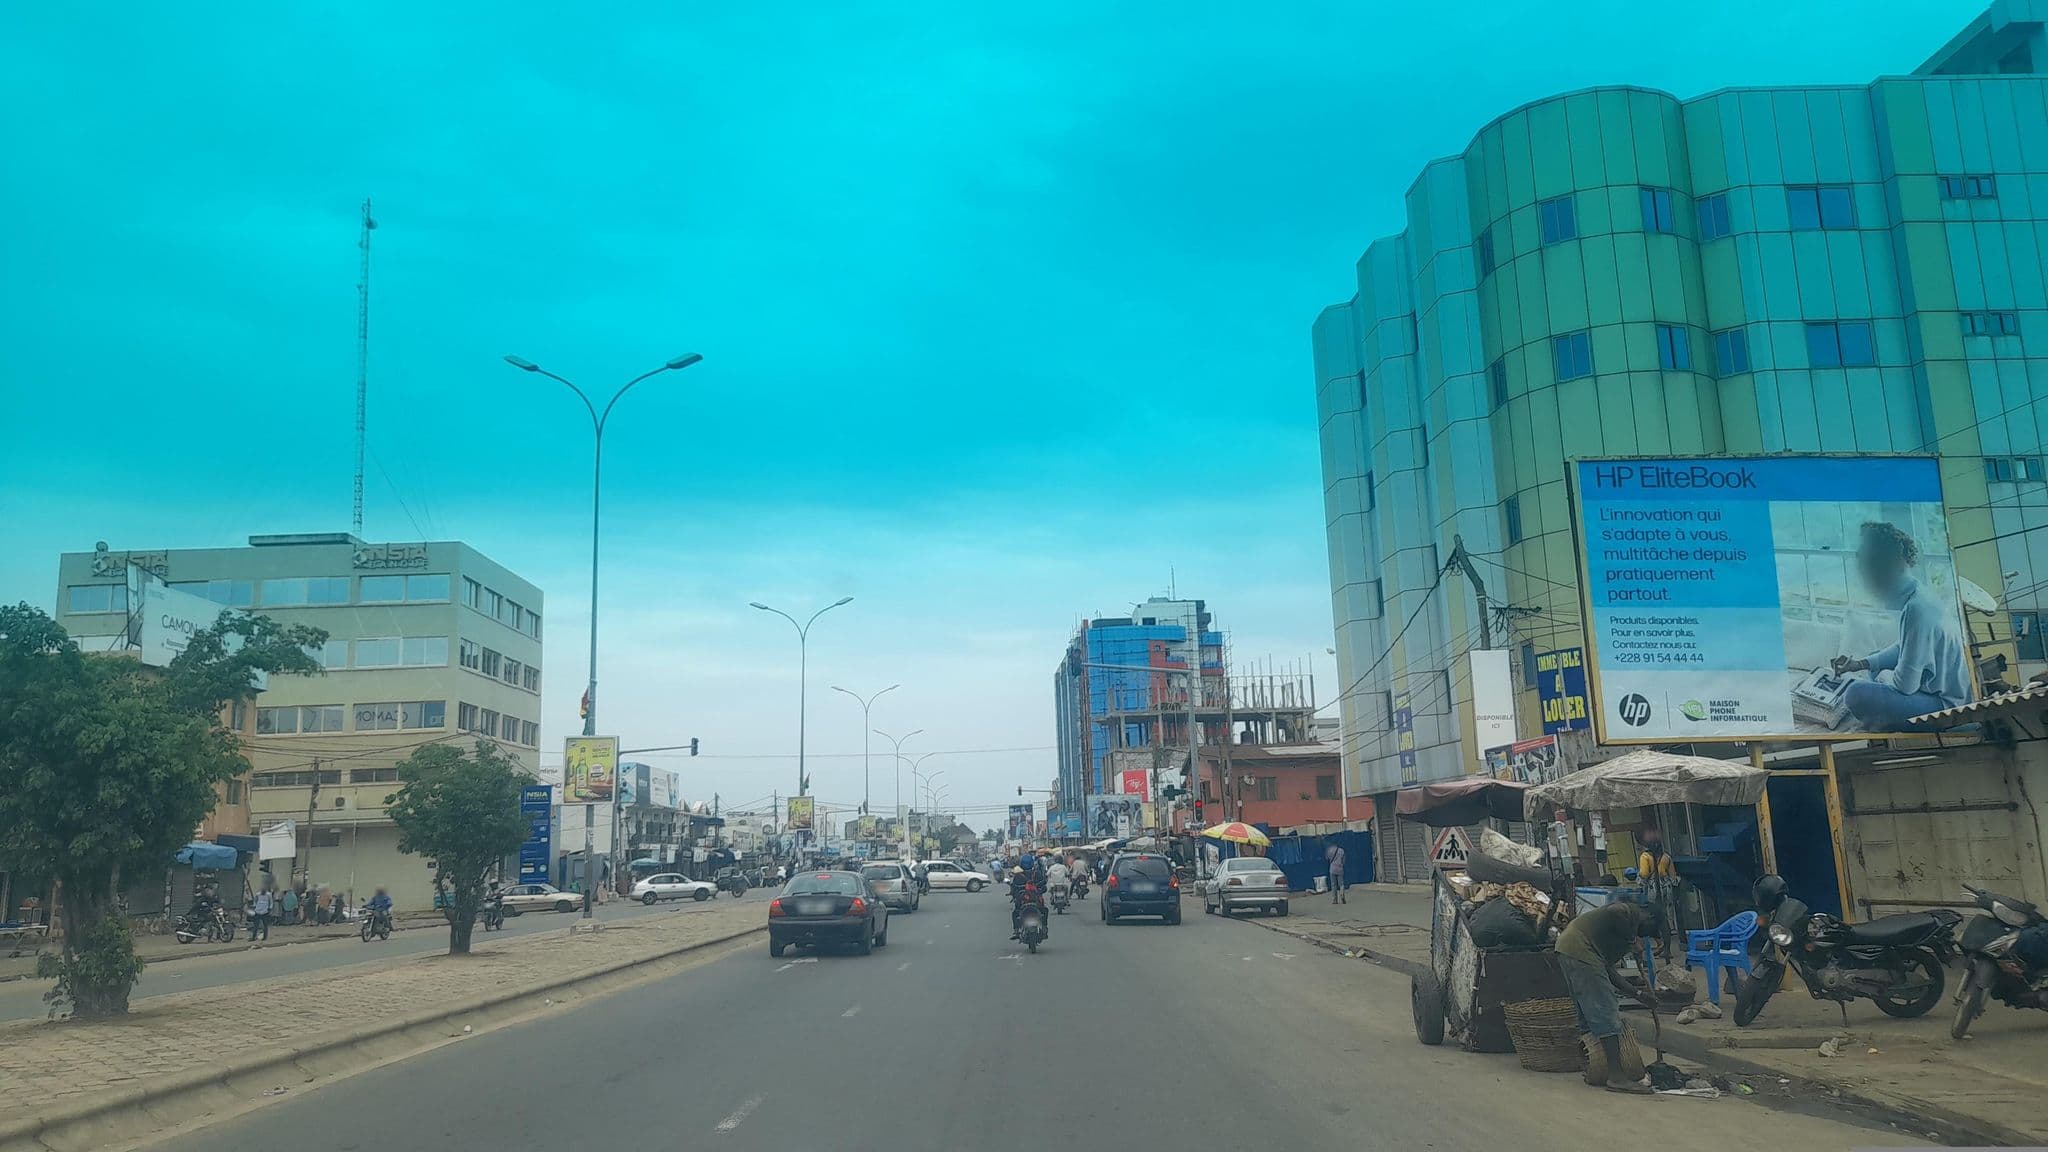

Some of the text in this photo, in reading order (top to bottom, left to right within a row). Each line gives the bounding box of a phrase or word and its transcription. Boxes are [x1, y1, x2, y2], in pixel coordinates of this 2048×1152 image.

[1596, 466, 1757, 489] HP EliteBook
[1600, 508, 1721, 523] L'innovation qui
[1602, 528, 1732, 543] s'adapte à vous,
[1604, 547, 1747, 563] multitâche depuis
[1606, 568, 1715, 583] pratiquement
[1608, 588, 1671, 602] partout.
[161, 614, 198, 636] CAMON
[1610, 616, 1700, 626] Produits disponibles.
[1611, 628, 1631, 636] Pour
[1646, 629, 1673, 637] savoir
[1612, 640, 1659, 649] Contactez
[1614, 653, 1704, 663] +228 91 54 44 44
[1623, 693, 1649, 727] hp
